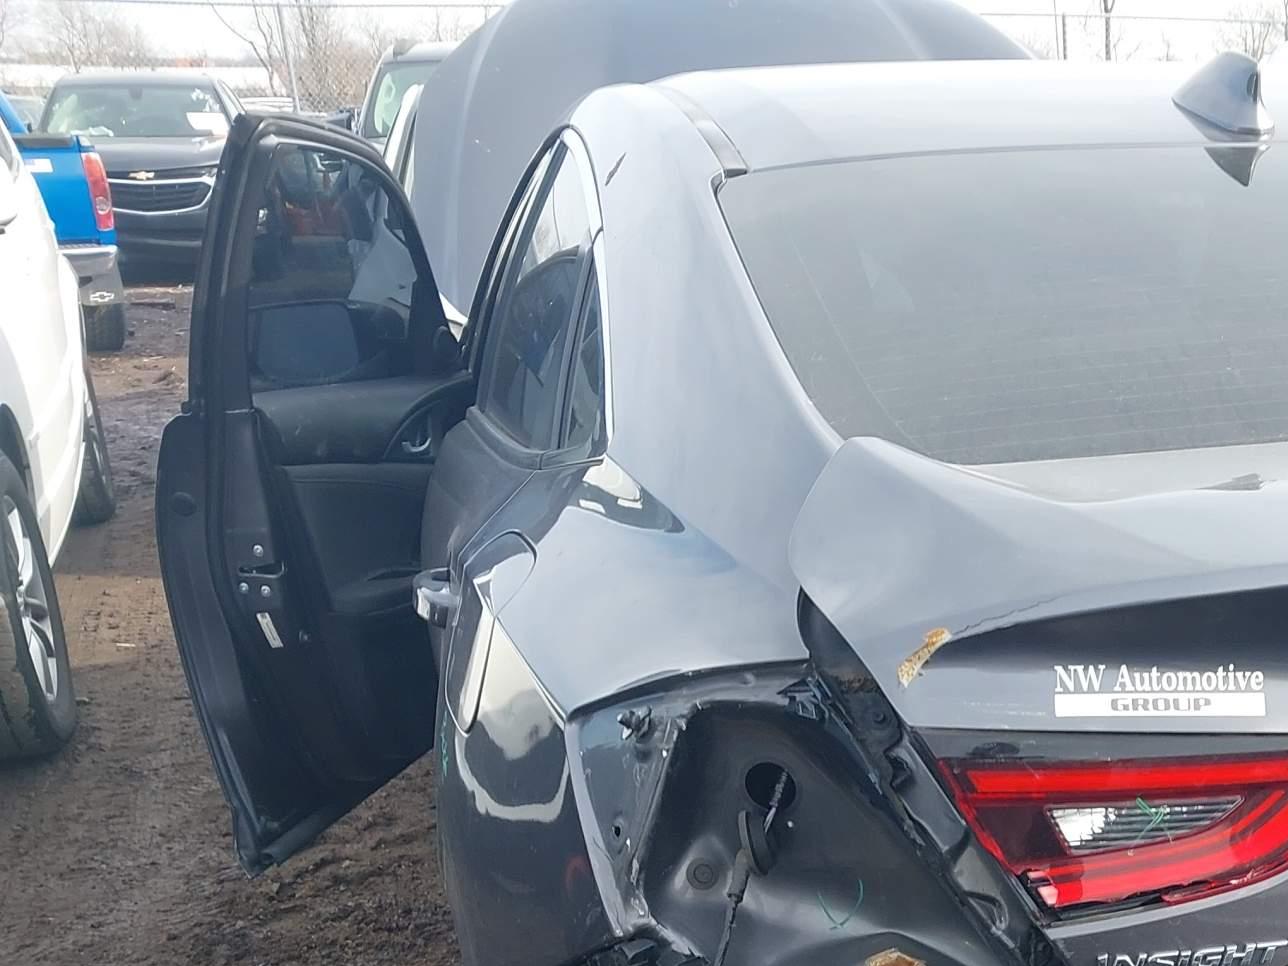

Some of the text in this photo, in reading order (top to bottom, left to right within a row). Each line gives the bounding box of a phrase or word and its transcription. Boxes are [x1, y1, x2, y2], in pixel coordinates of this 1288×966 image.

[1054, 664, 1265, 692] NW Automotive
[1110, 697, 1212, 712] GROUP
